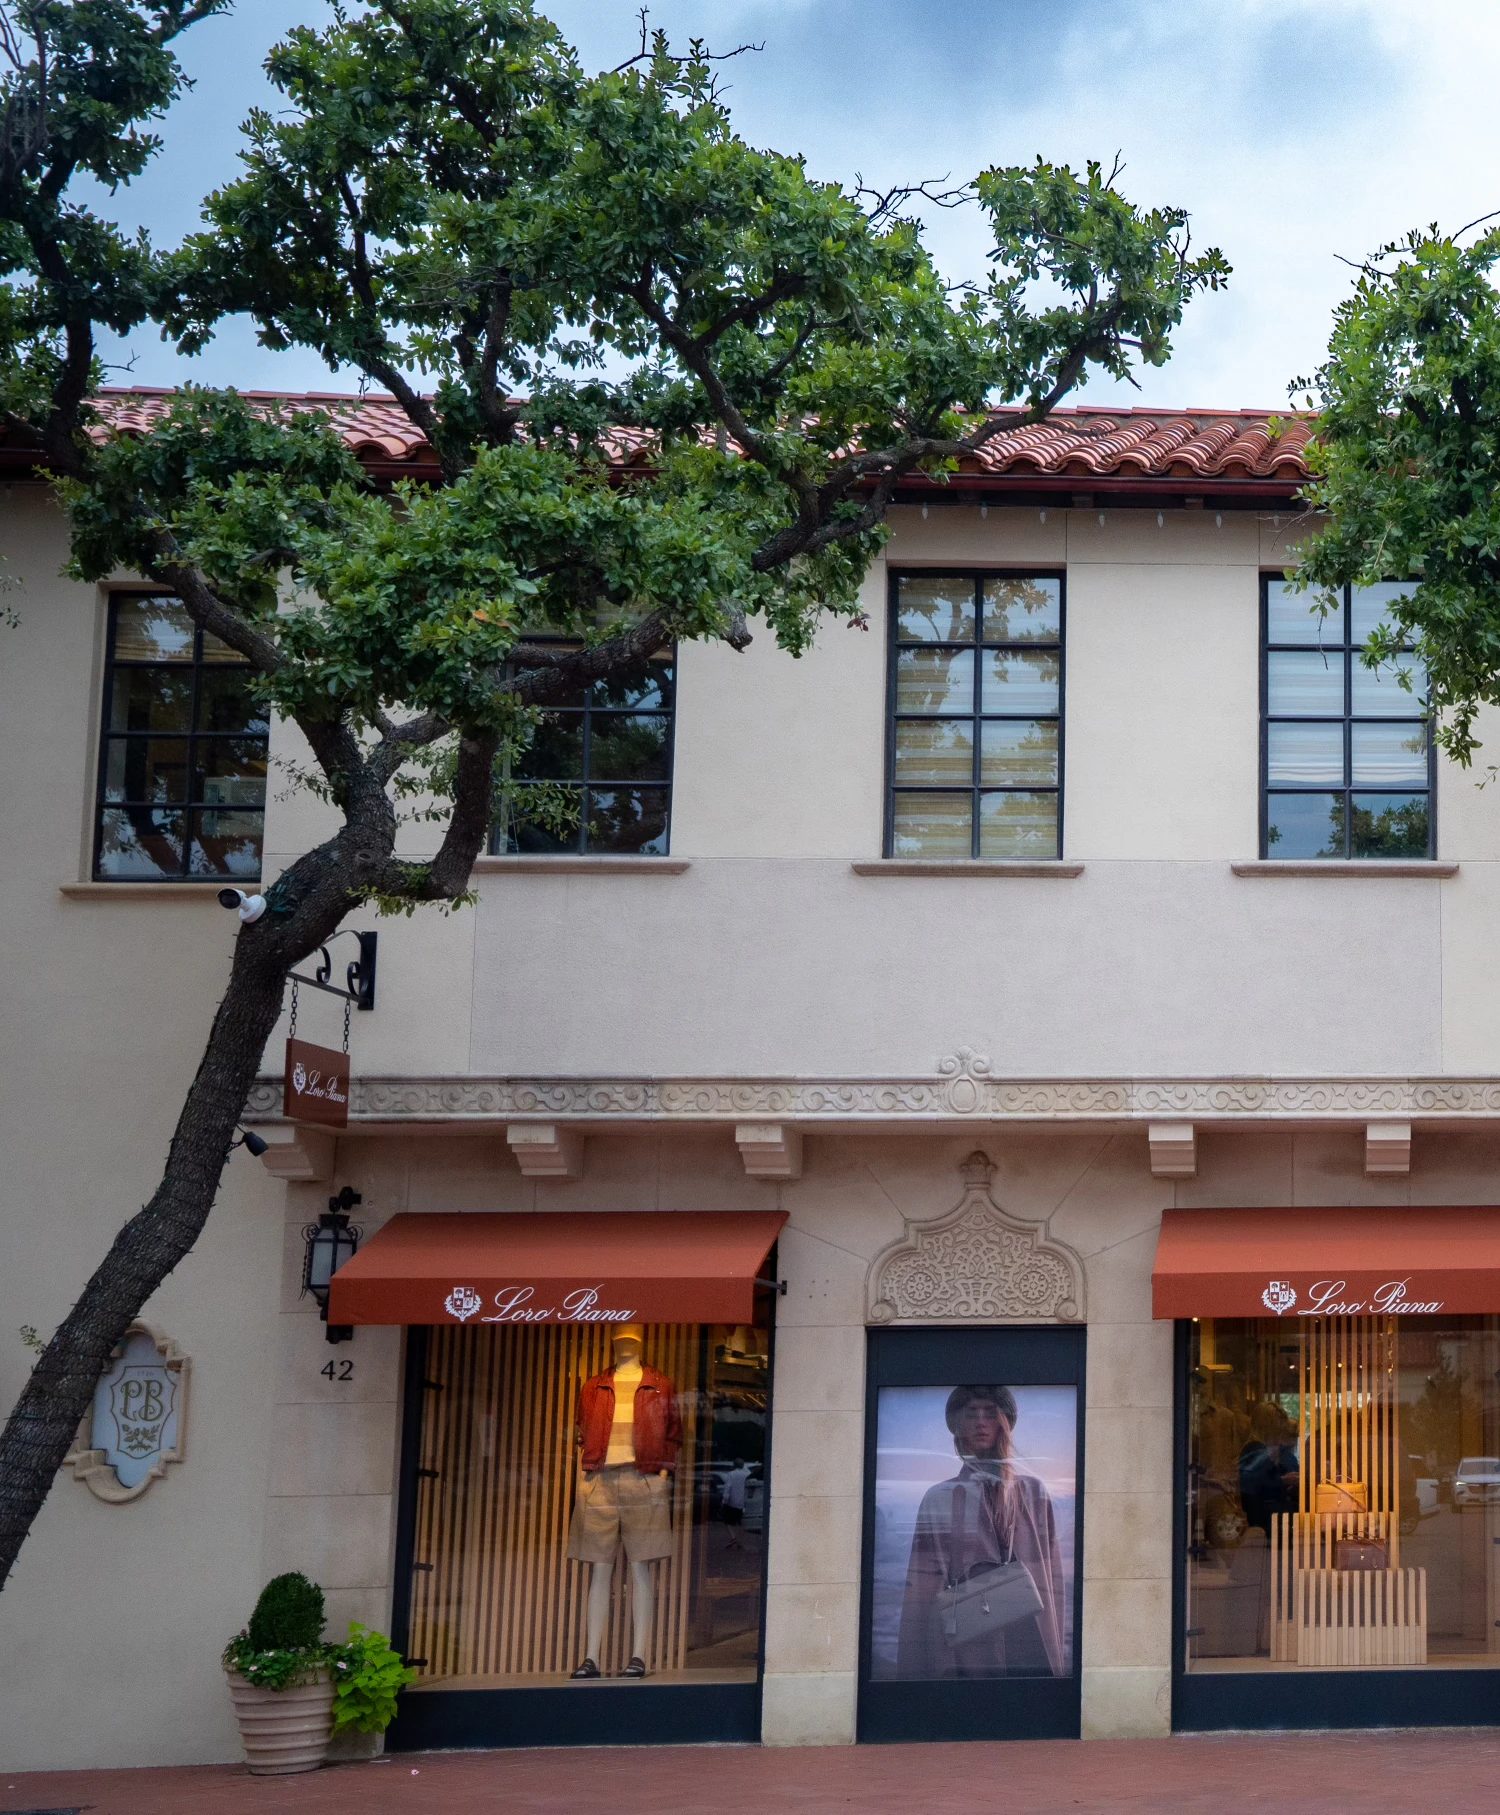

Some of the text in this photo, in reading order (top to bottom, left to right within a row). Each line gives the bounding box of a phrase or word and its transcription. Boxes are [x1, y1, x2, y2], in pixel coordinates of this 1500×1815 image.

[305, 1069, 326, 1097] Loro
[481, 1283, 637, 1322] Loro Piana
[1297, 1276, 1445, 1315] Loro Piana
[320, 1359, 354, 1381] 42
[120, 1379, 164, 1422] PB
